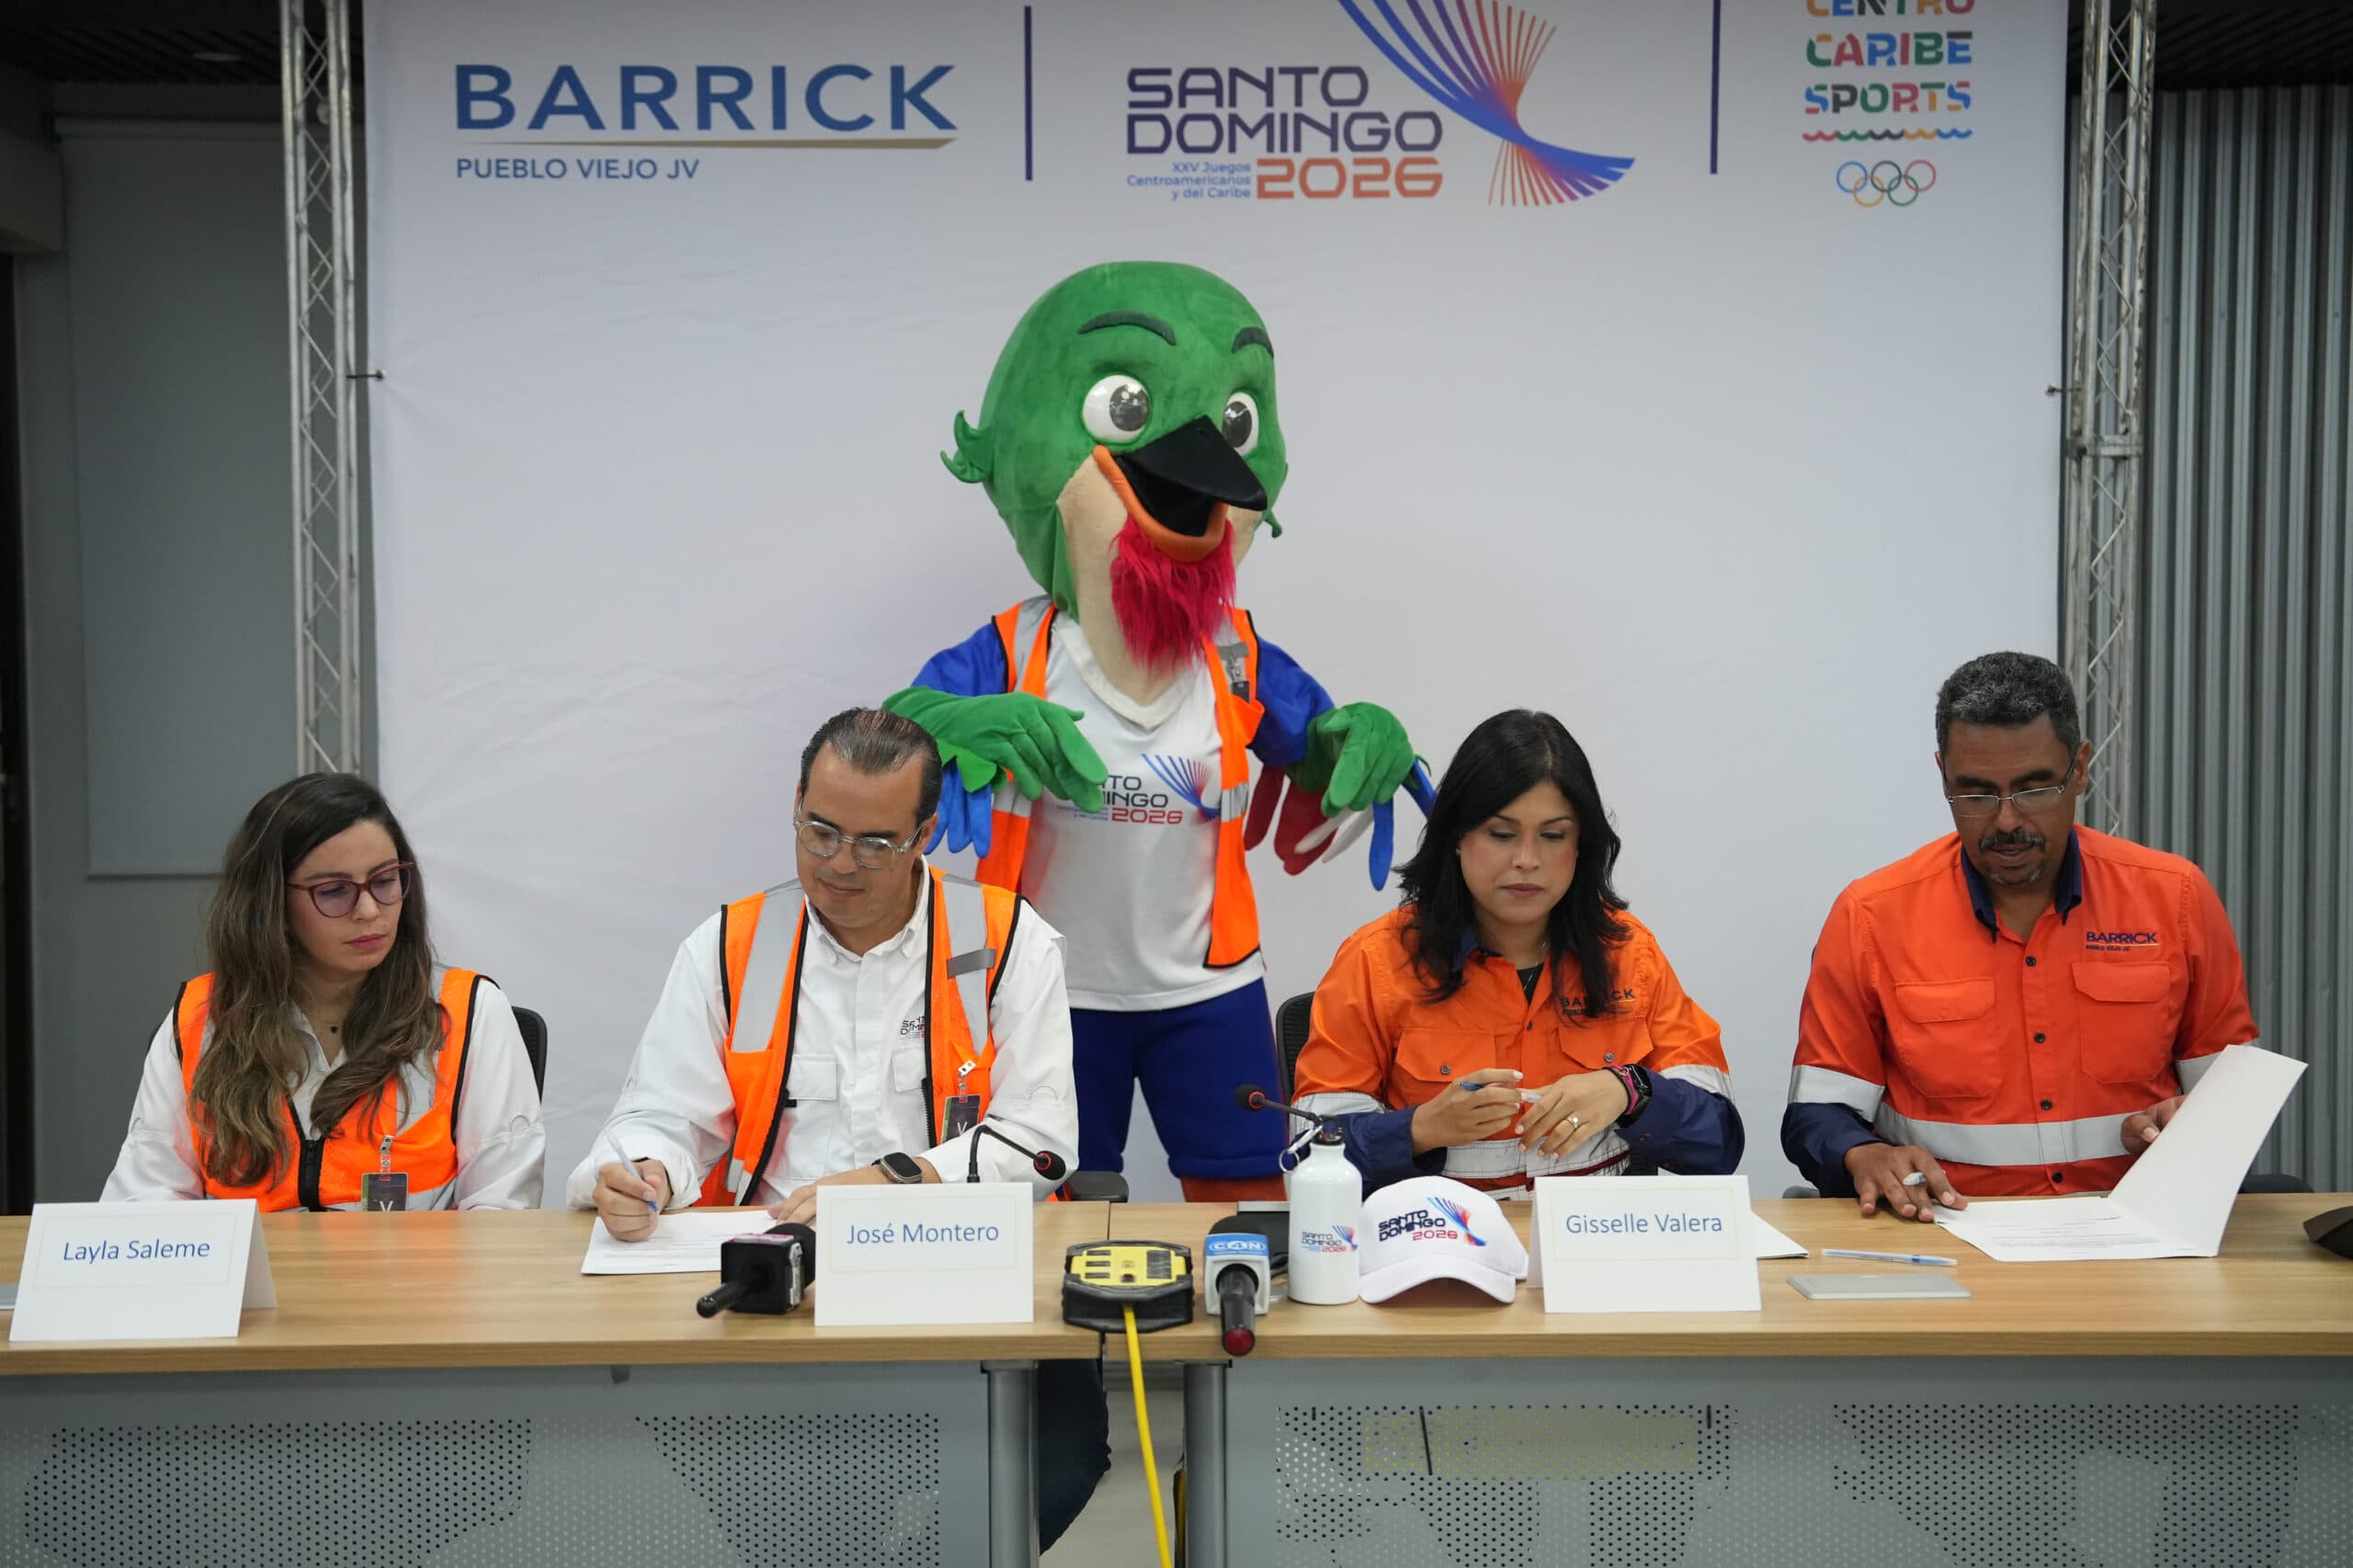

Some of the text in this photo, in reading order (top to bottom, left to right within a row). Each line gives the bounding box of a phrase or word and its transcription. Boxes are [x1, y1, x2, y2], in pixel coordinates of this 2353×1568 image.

[1806, 31, 1973, 67] CARIBE
[456, 63, 959, 132] BARRICK
[1127, 66, 1369, 108] SANTO
[1805, 81, 1972, 114] SPORTS
[1127, 111, 1443, 154] DOMINGO
[457, 158, 700, 179] PUEBLO VIEJO JV
[1127, 175, 1251, 186] Centroamericanos
[1172, 162, 1251, 176] XXV Juegos
[1256, 157, 1443, 199] 2026
[1171, 187, 1251, 201] y del Caribe
[1111, 807, 1184, 824] 2026
[2086, 931, 2158, 945] BARRICK
[847, 1222, 999, 1244] José Montero
[1378, 1209, 1428, 1233] SANTO
[1379, 1218, 1447, 1243] DOMINGO
[1565, 1212, 1722, 1233] Gisselle Valera
[63, 1238, 210, 1265] Layla Saleme
